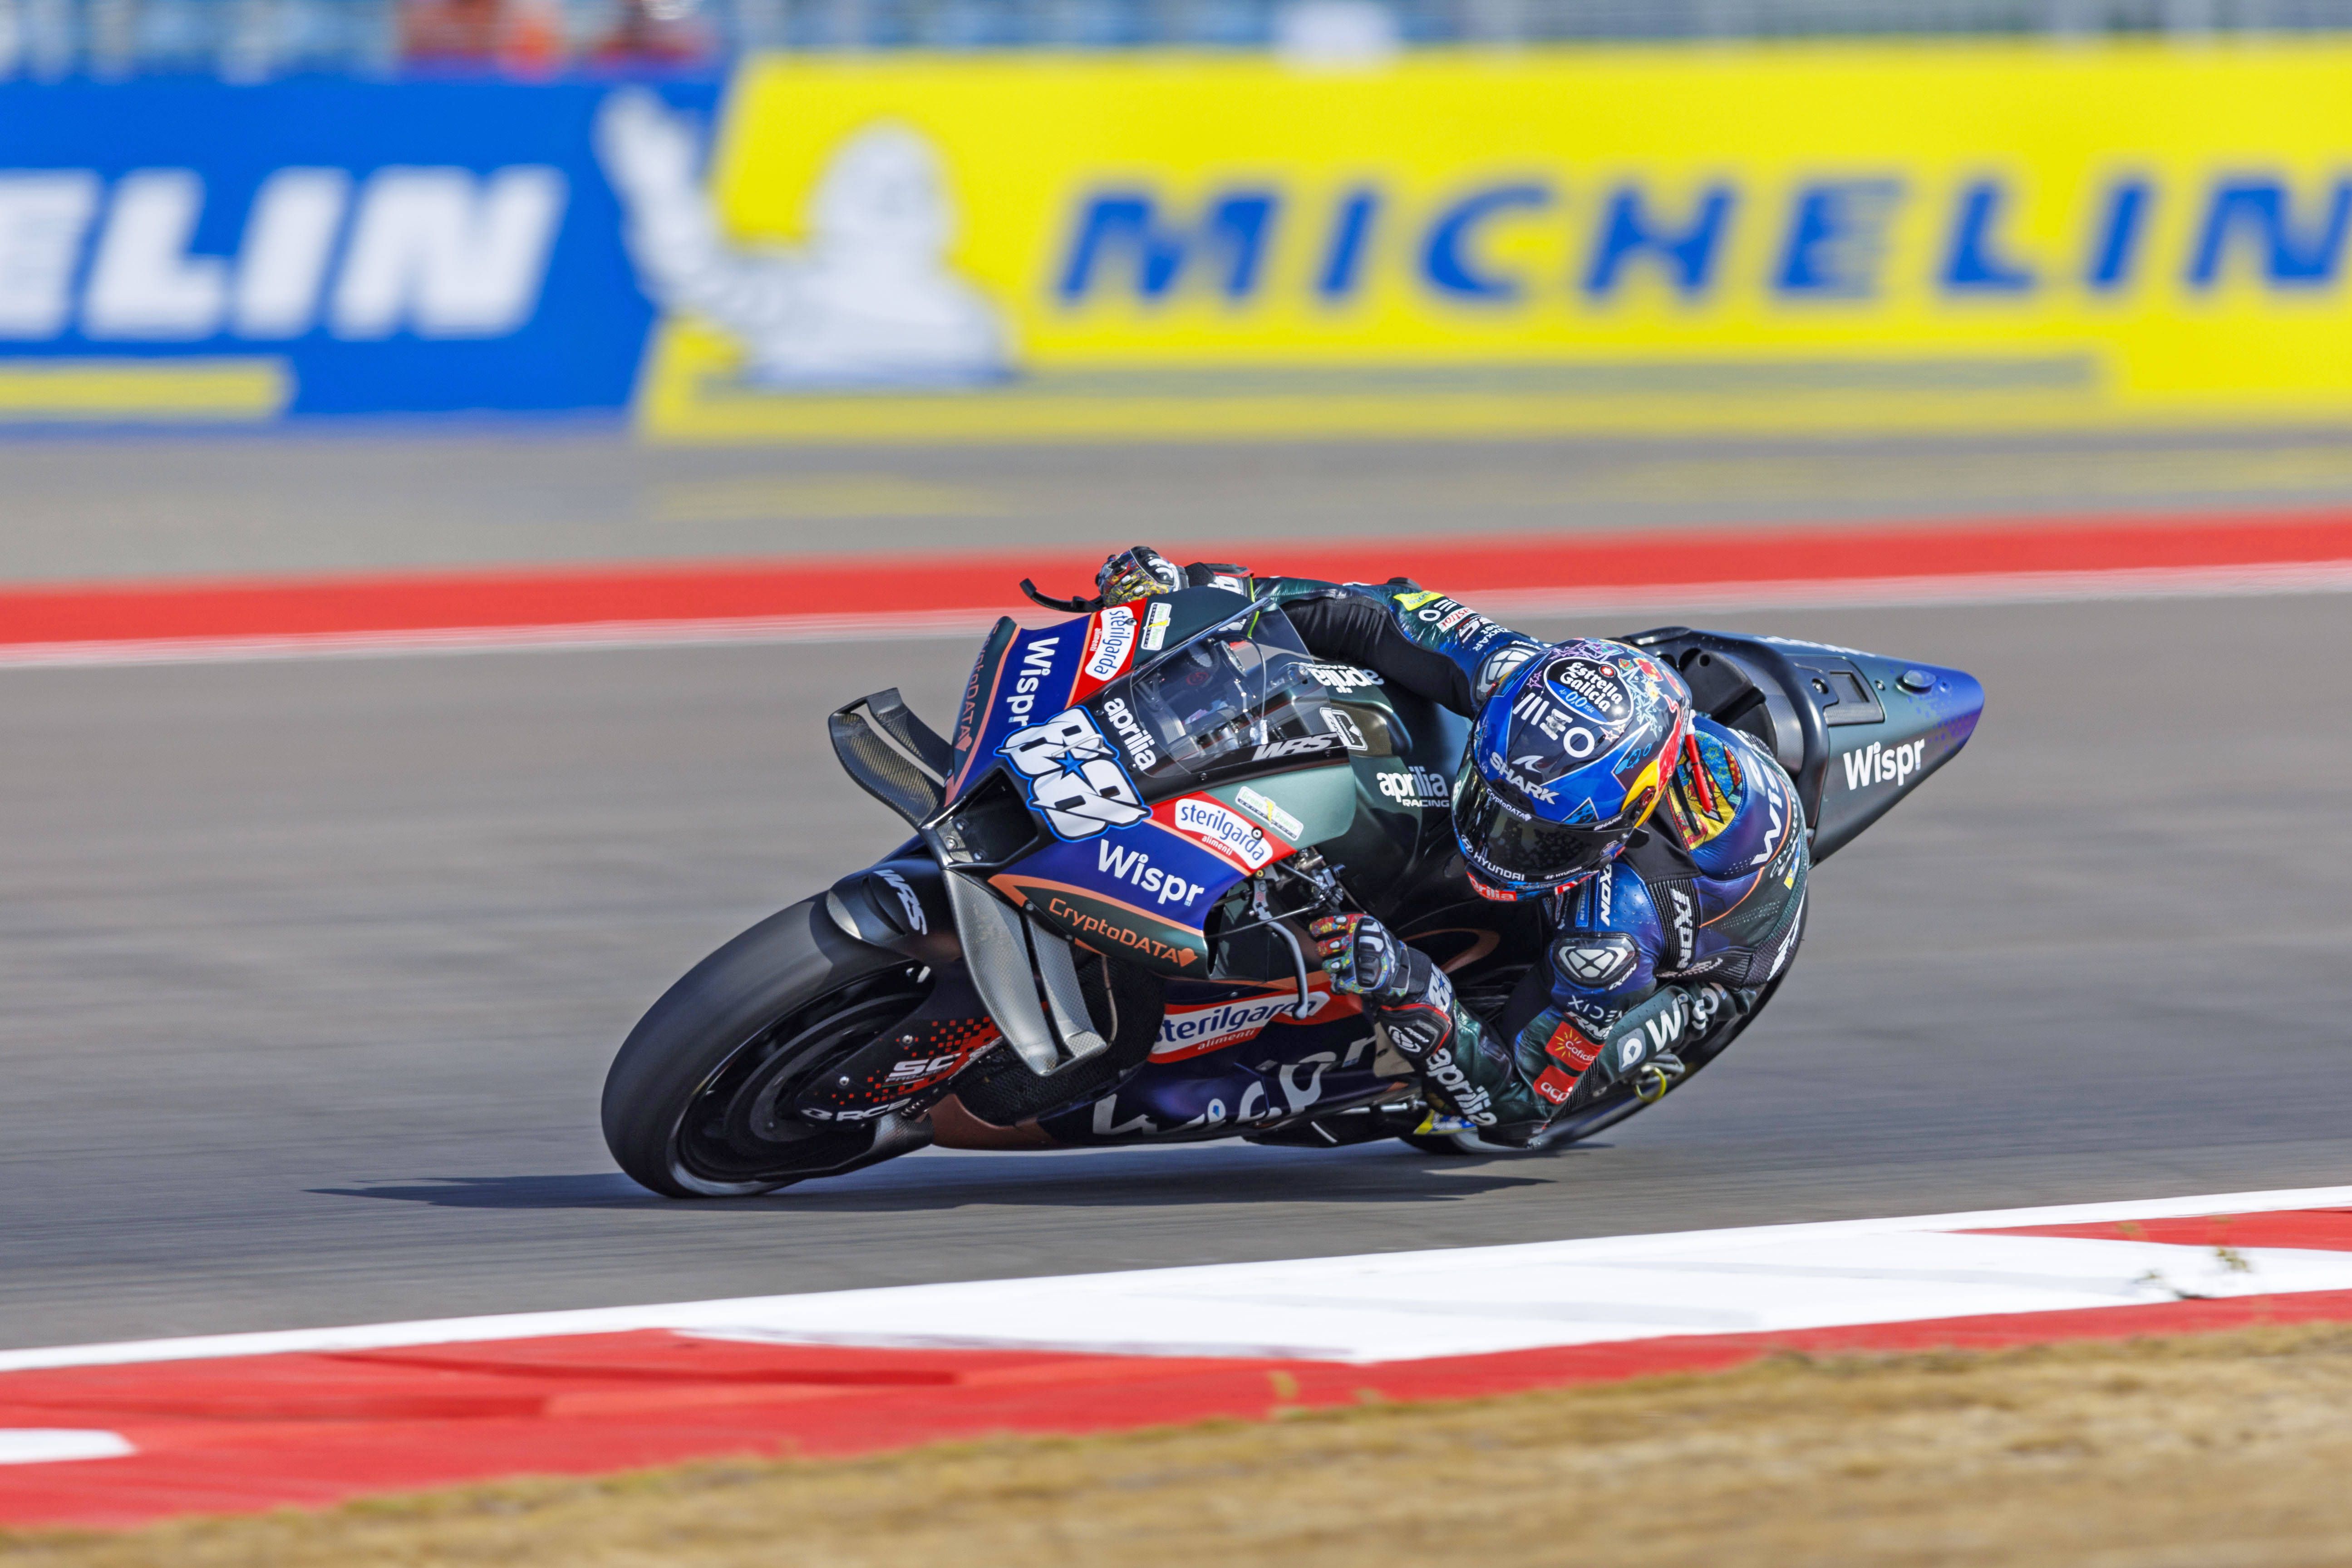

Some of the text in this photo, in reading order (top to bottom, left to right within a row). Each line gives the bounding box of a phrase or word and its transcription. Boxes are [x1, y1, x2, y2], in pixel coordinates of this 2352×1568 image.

[1053, 179, 2352, 300] MICHELIN
[1085, 610, 1130, 674] sterilgarda
[1089, 628, 1102, 651] alimenti
[1006, 637, 1059, 727] Wispr
[1560, 671, 1611, 712] Galicia
[1566, 662, 1623, 704] Estrella
[1103, 698, 1157, 772] aprilia
[1251, 732, 1338, 762] WRS
[1512, 692, 1595, 758] MEO
[997, 706, 1151, 839] 88
[1377, 766, 1449, 806] aprilia
[1490, 752, 1560, 805] SHARK
[1843, 738, 1925, 791] Wispr
[1402, 799, 1450, 807] RACING
[1486, 788, 1526, 820] CryptoDATA
[1181, 805, 1265, 861] sterilgarda
[1201, 835, 1232, 856] alimenti
[1098, 839, 1204, 906] Wispr
[1474, 852, 1525, 881] HYUNDAI
[1555, 865, 1582, 878] HYUNDAI
[1049, 898, 1180, 964] CryptoDATA
[1197, 1027, 1256, 1051] alimenti
[888, 1052, 963, 1078] SC
[1425, 1048, 1497, 1126] aprilia
